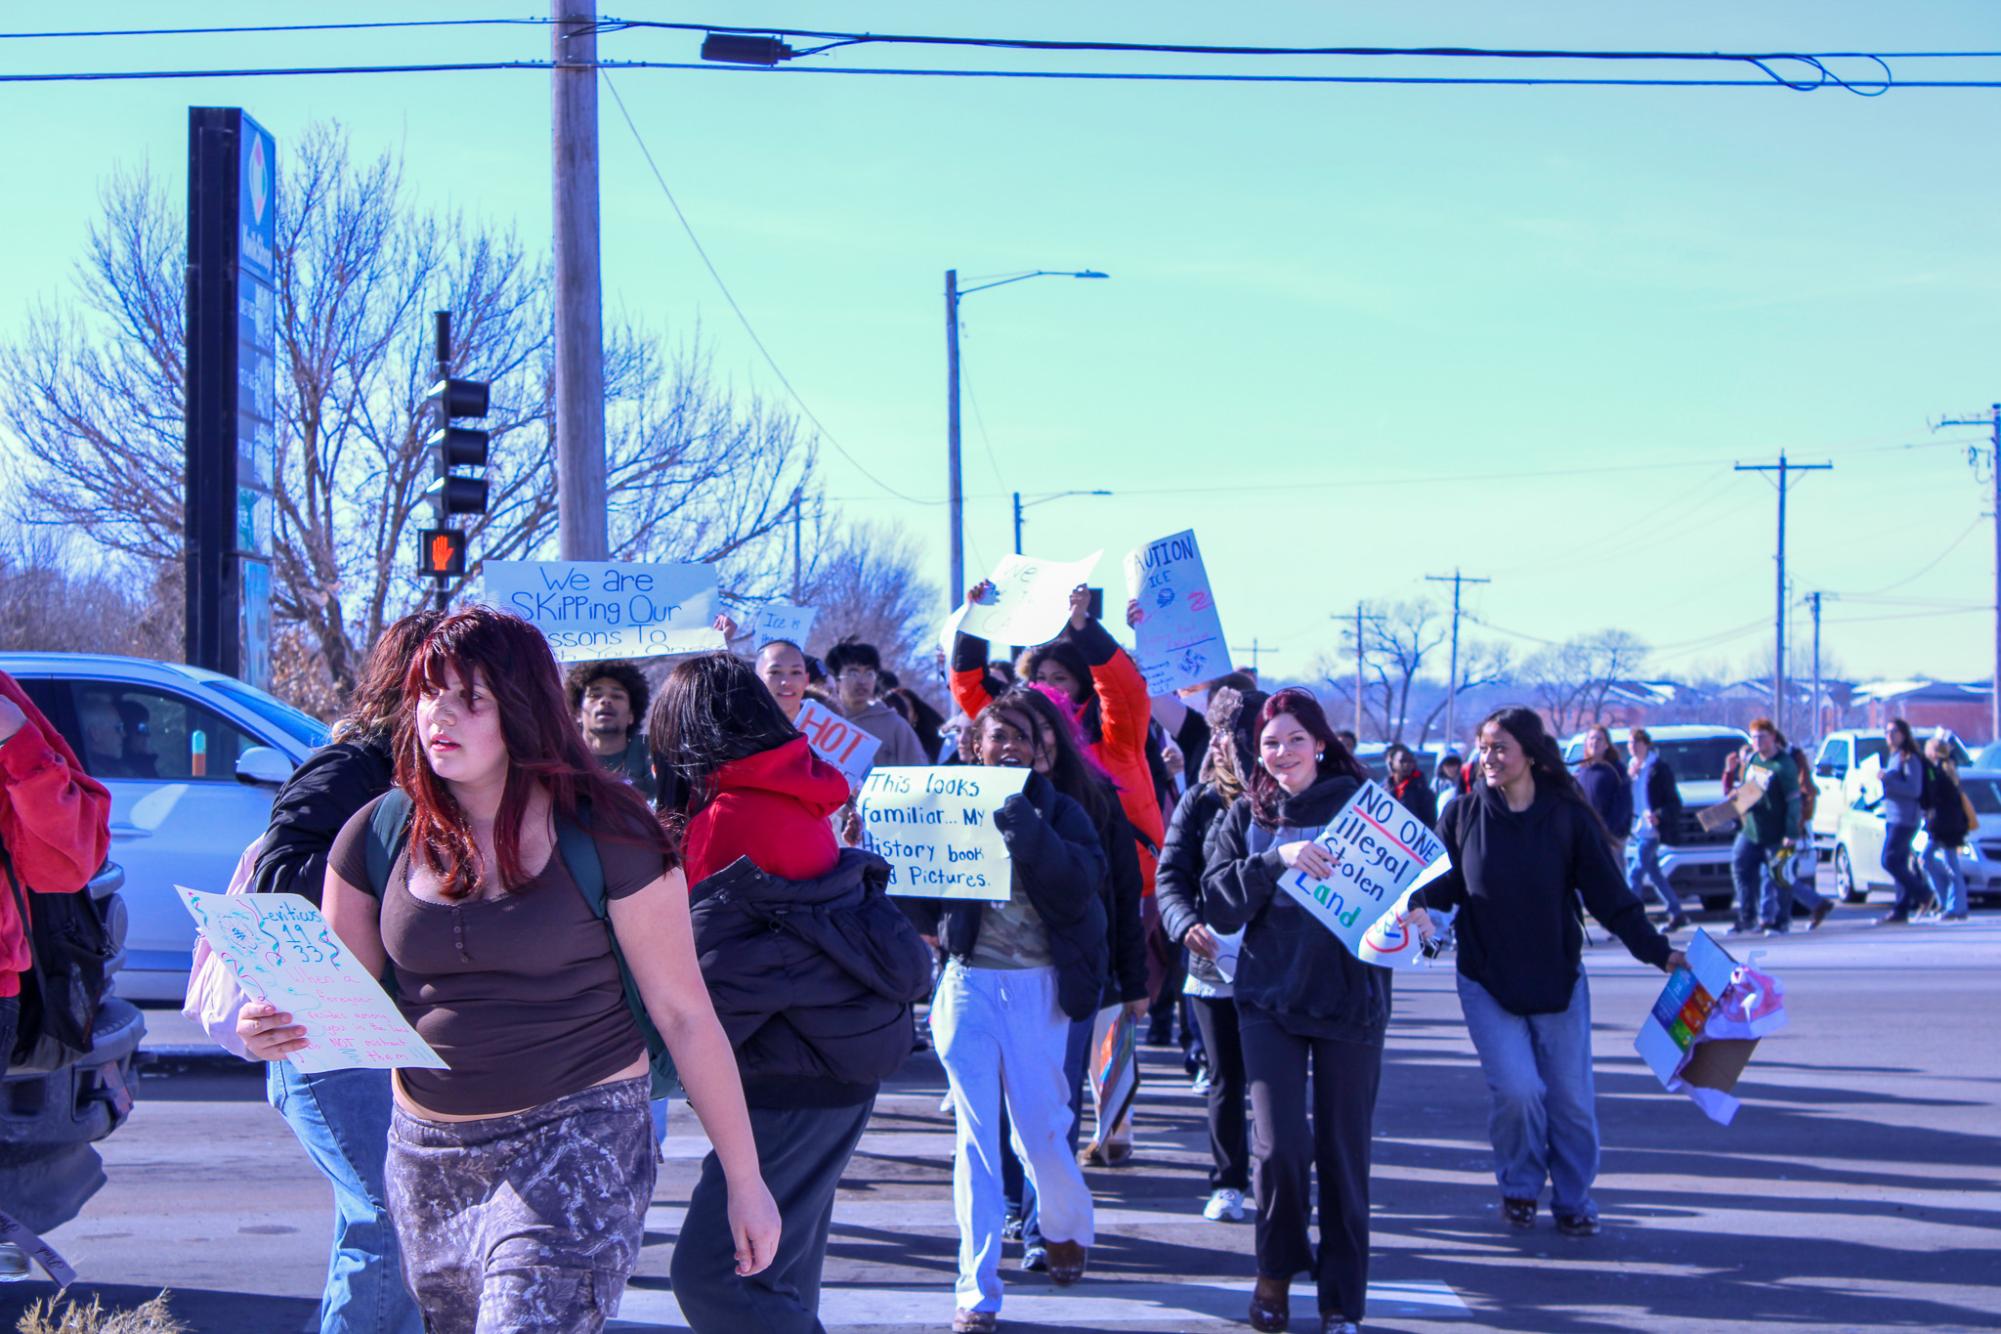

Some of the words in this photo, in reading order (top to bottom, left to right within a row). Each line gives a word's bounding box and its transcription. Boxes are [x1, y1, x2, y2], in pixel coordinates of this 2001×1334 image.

[1135, 535, 1194, 571] UTION
[540, 566, 590, 591] We
[603, 569, 655, 592] are
[1148, 569, 1171, 588] ICE
[629, 594, 682, 623] Our
[548, 630, 622, 648] ssons
[627, 623, 667, 643] To
[799, 707, 871, 764] HOT
[870, 773, 911, 793] This
[926, 773, 979, 797] looks
[1357, 784, 1393, 823] NO
[1400, 820, 1439, 863] ONE
[862, 831, 935, 862] History
[948, 844, 984, 862] book
[1336, 810, 1410, 884] illegal
[909, 866, 991, 887] Pictures.
[1324, 837, 1385, 901] Stolen
[1295, 872, 1361, 928] Land
[282, 924, 311, 945] 19
[293, 944, 323, 963] 33
